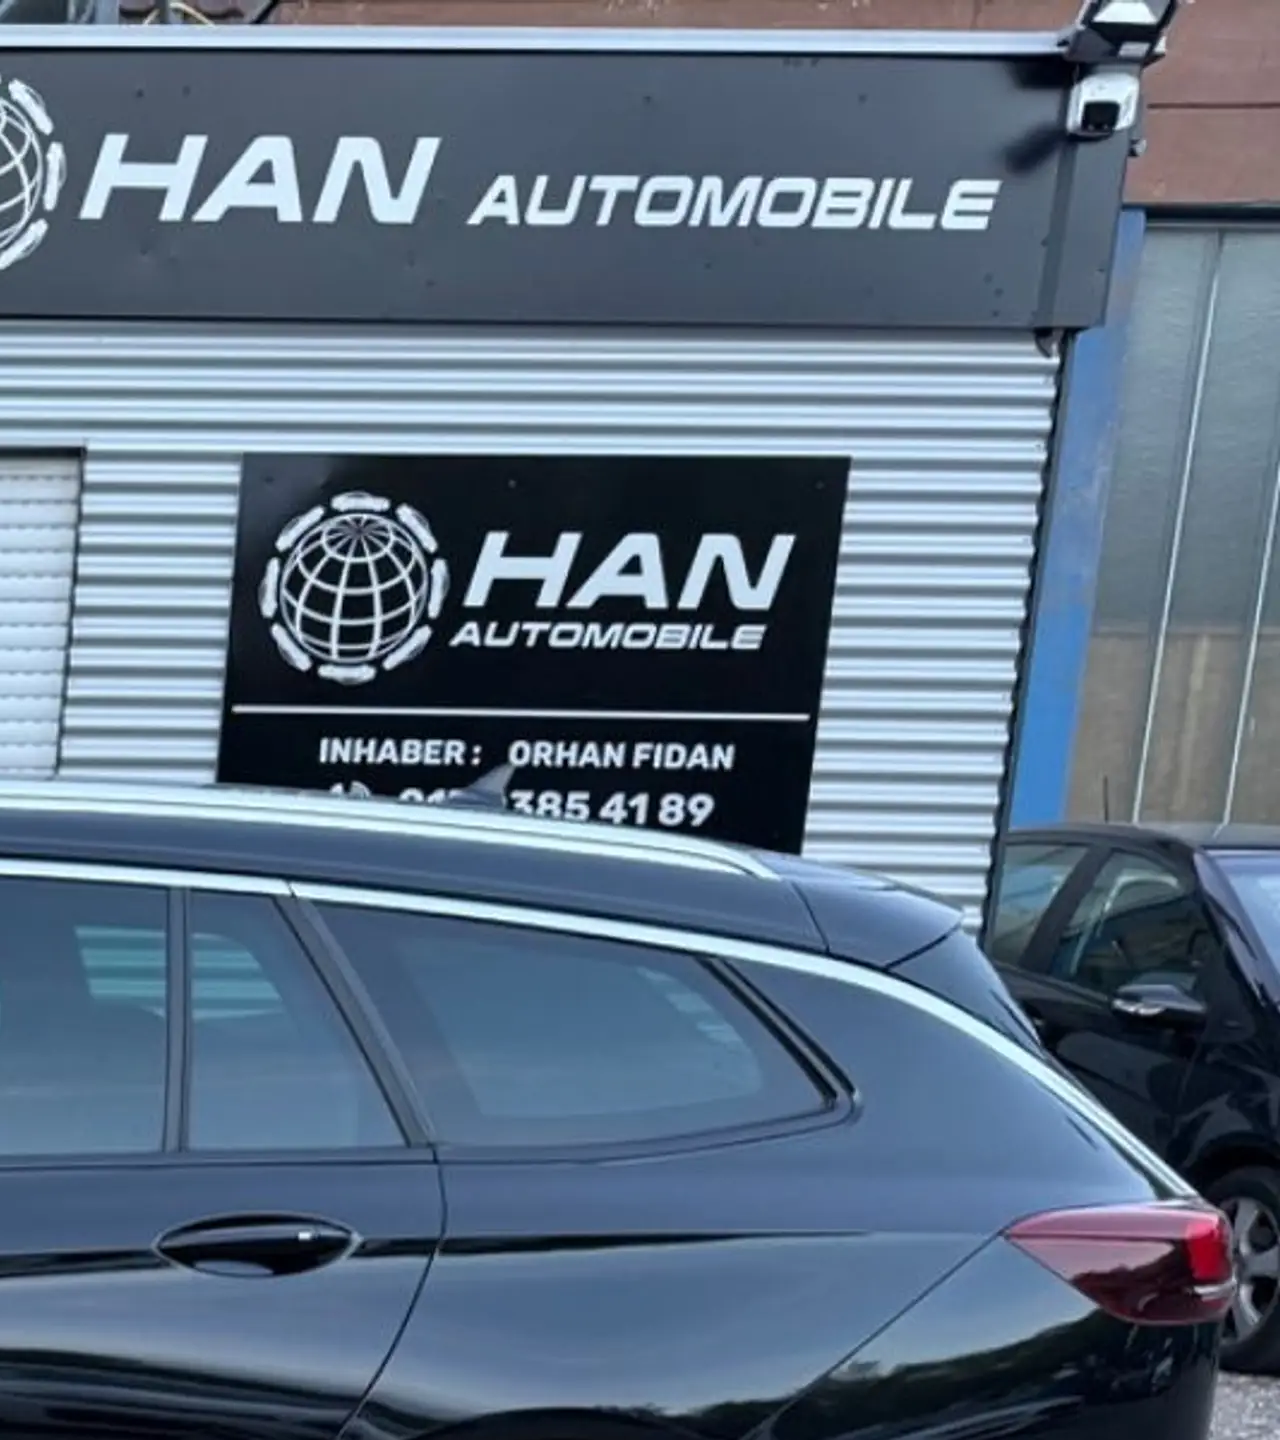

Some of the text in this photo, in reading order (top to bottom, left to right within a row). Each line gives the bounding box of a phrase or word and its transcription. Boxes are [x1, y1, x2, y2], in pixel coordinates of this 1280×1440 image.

[78, 132, 1003, 231] HAN AUTOMOBILE
[463, 531, 796, 610] HAN
[449, 621, 767, 650] AUTOMOBILE
[508, 740, 626, 768] ORHAN
[632, 742, 735, 769] FIDAN
